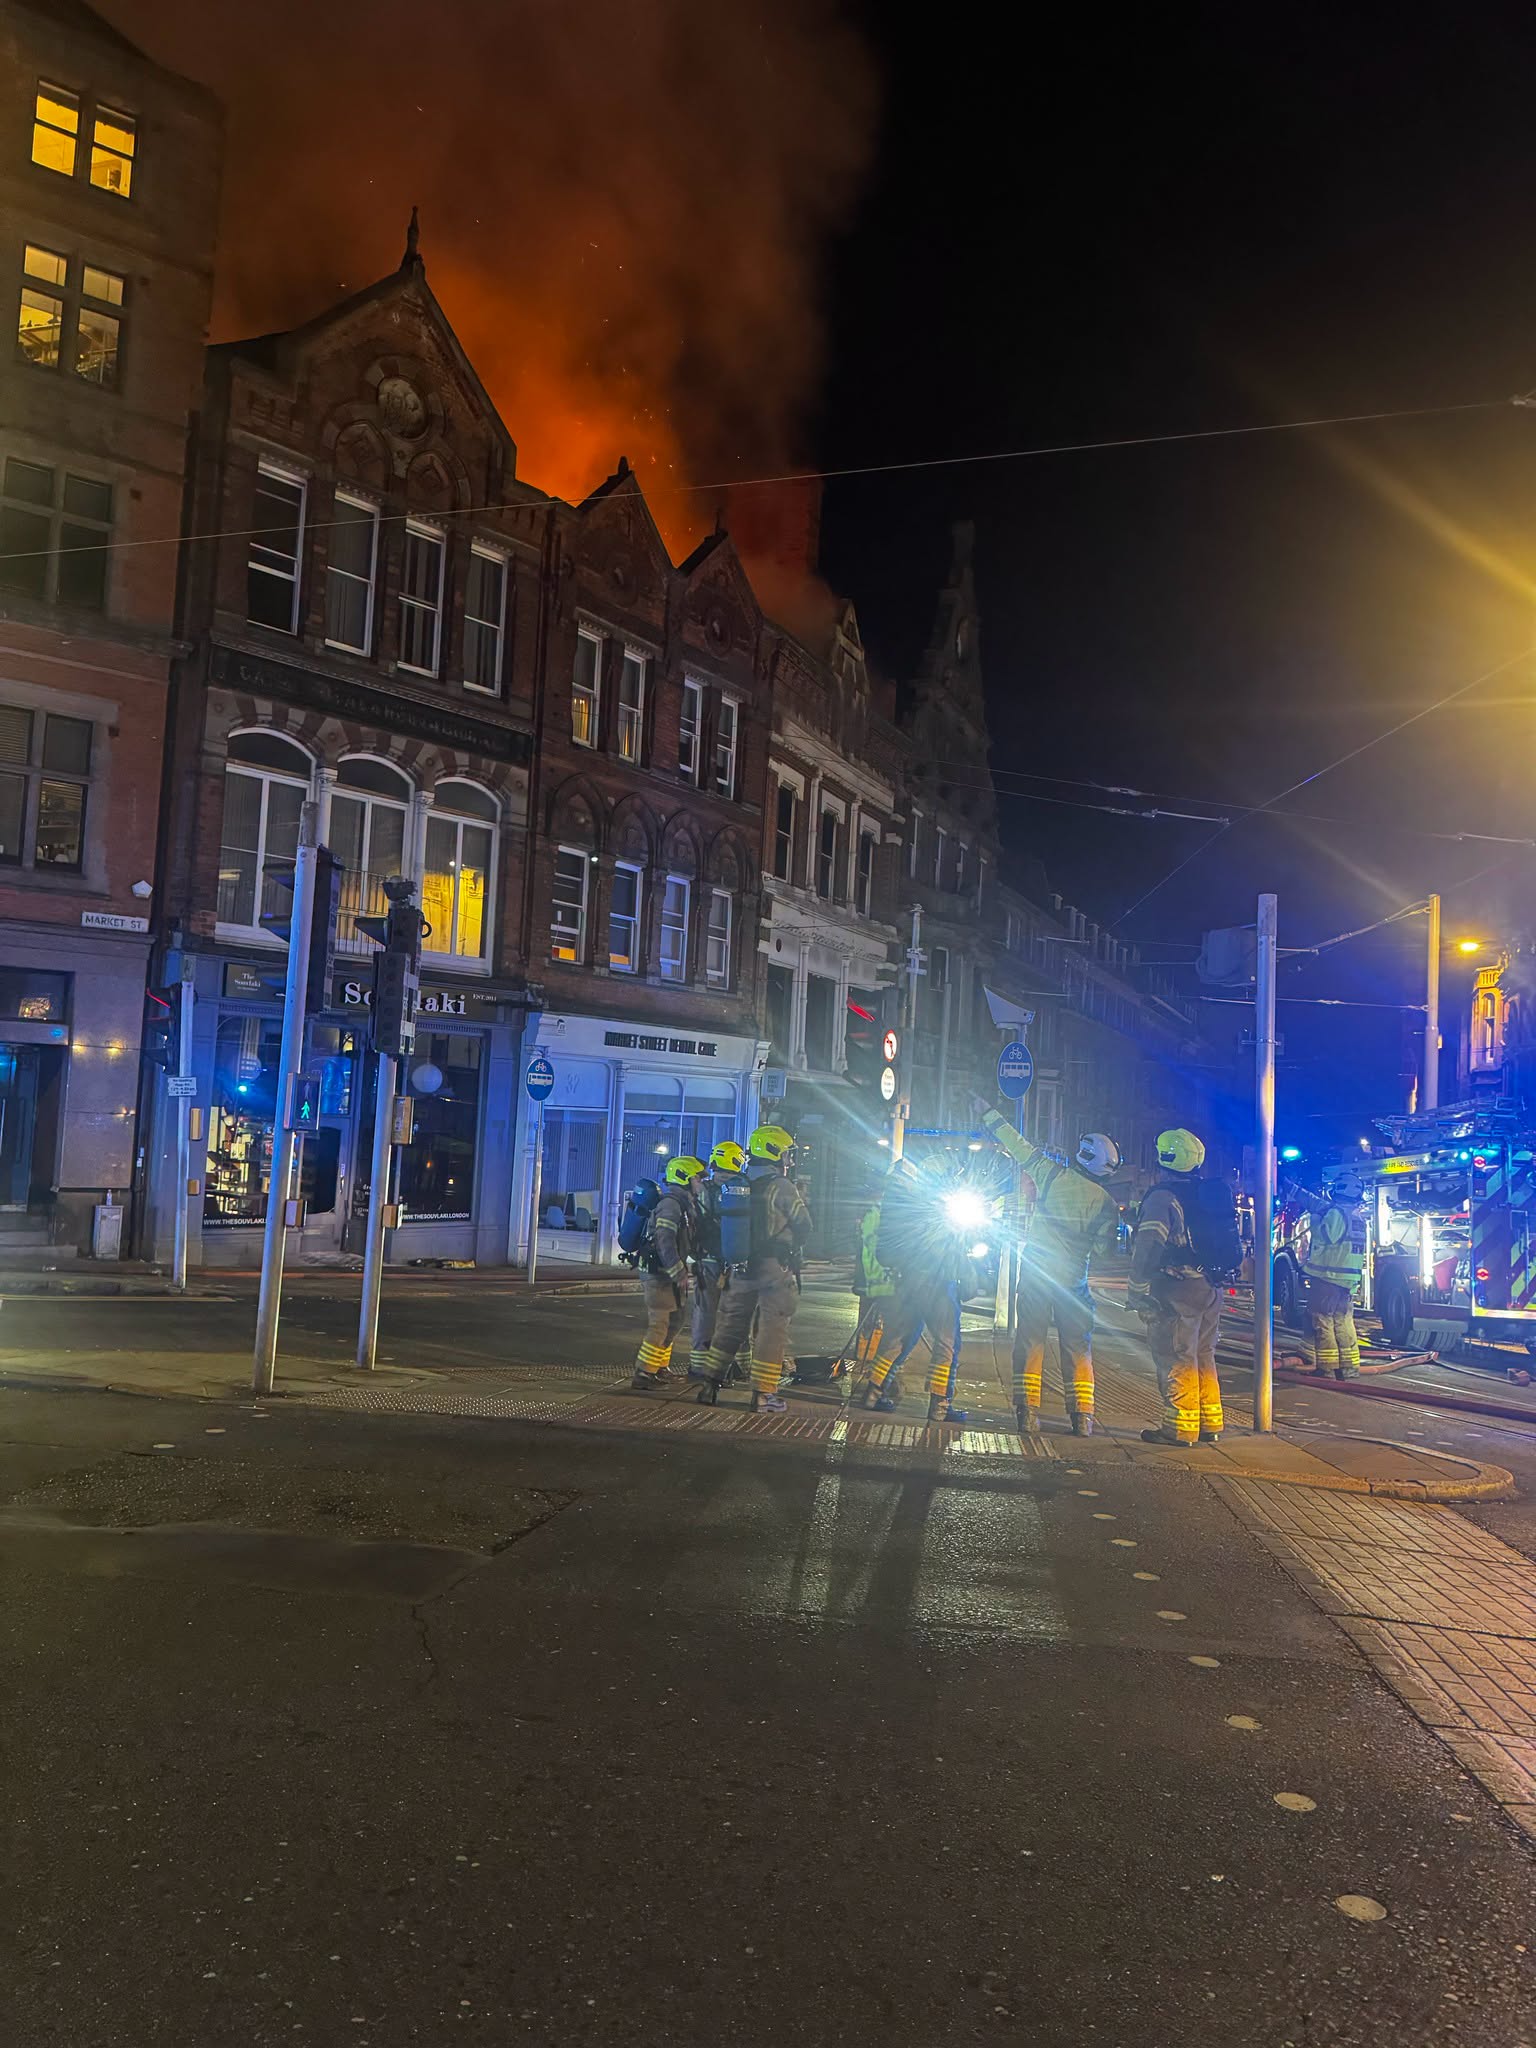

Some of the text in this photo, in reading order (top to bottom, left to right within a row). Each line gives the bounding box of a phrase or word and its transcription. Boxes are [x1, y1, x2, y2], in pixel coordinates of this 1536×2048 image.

[85, 915, 126, 927] MARKET
[242, 972, 255, 980] The
[234, 979, 261, 988] Souvlaki
[604, 1031, 718, 1057] MARKET STREET DENTAL CARE
